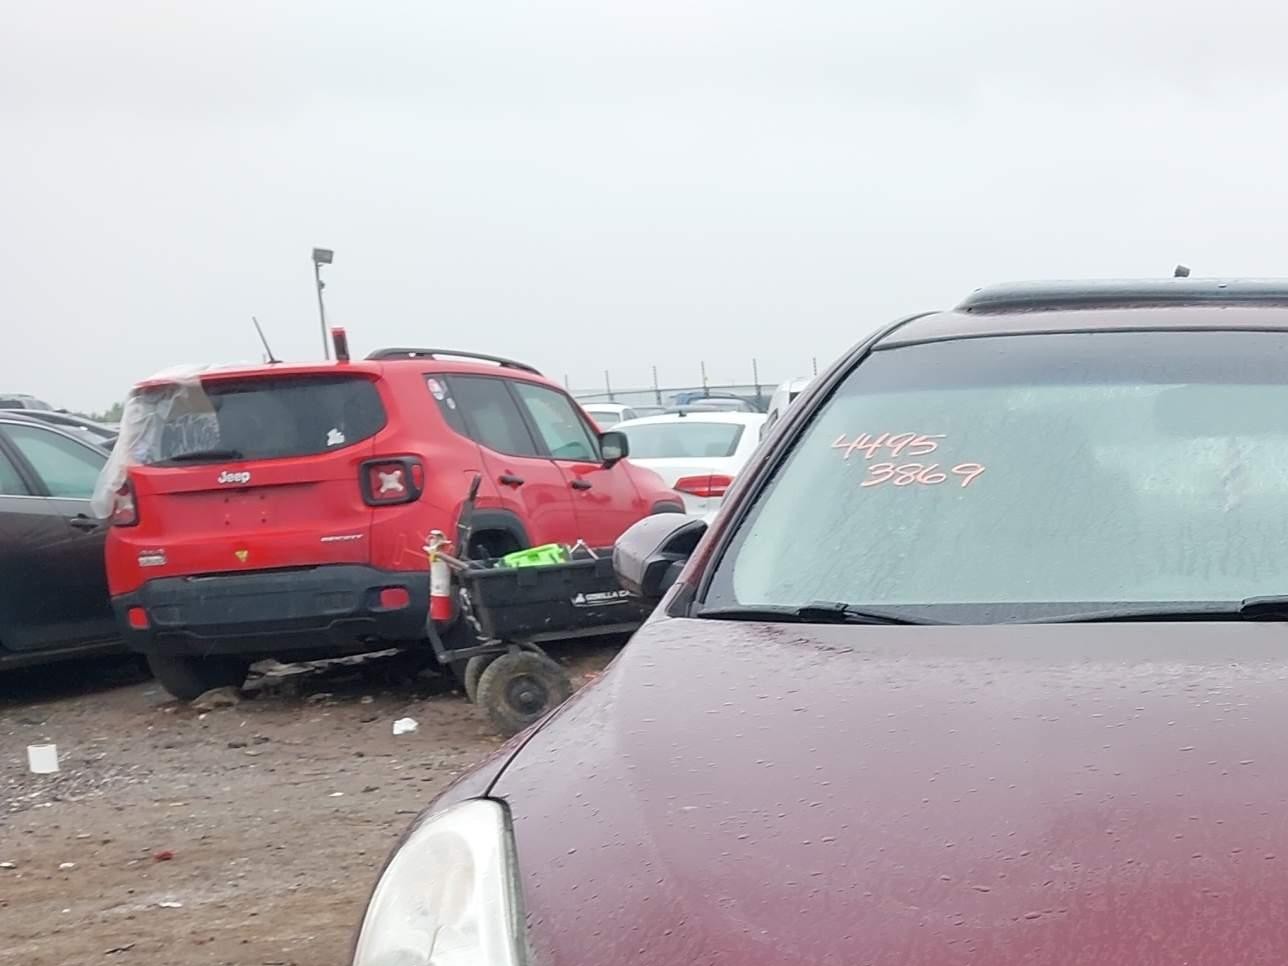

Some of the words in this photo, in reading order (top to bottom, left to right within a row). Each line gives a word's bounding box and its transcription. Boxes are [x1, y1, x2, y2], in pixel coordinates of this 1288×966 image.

[831, 432, 947, 460] 4495
[217, 470, 251, 484] Jeep
[860, 462, 986, 488] 3869
